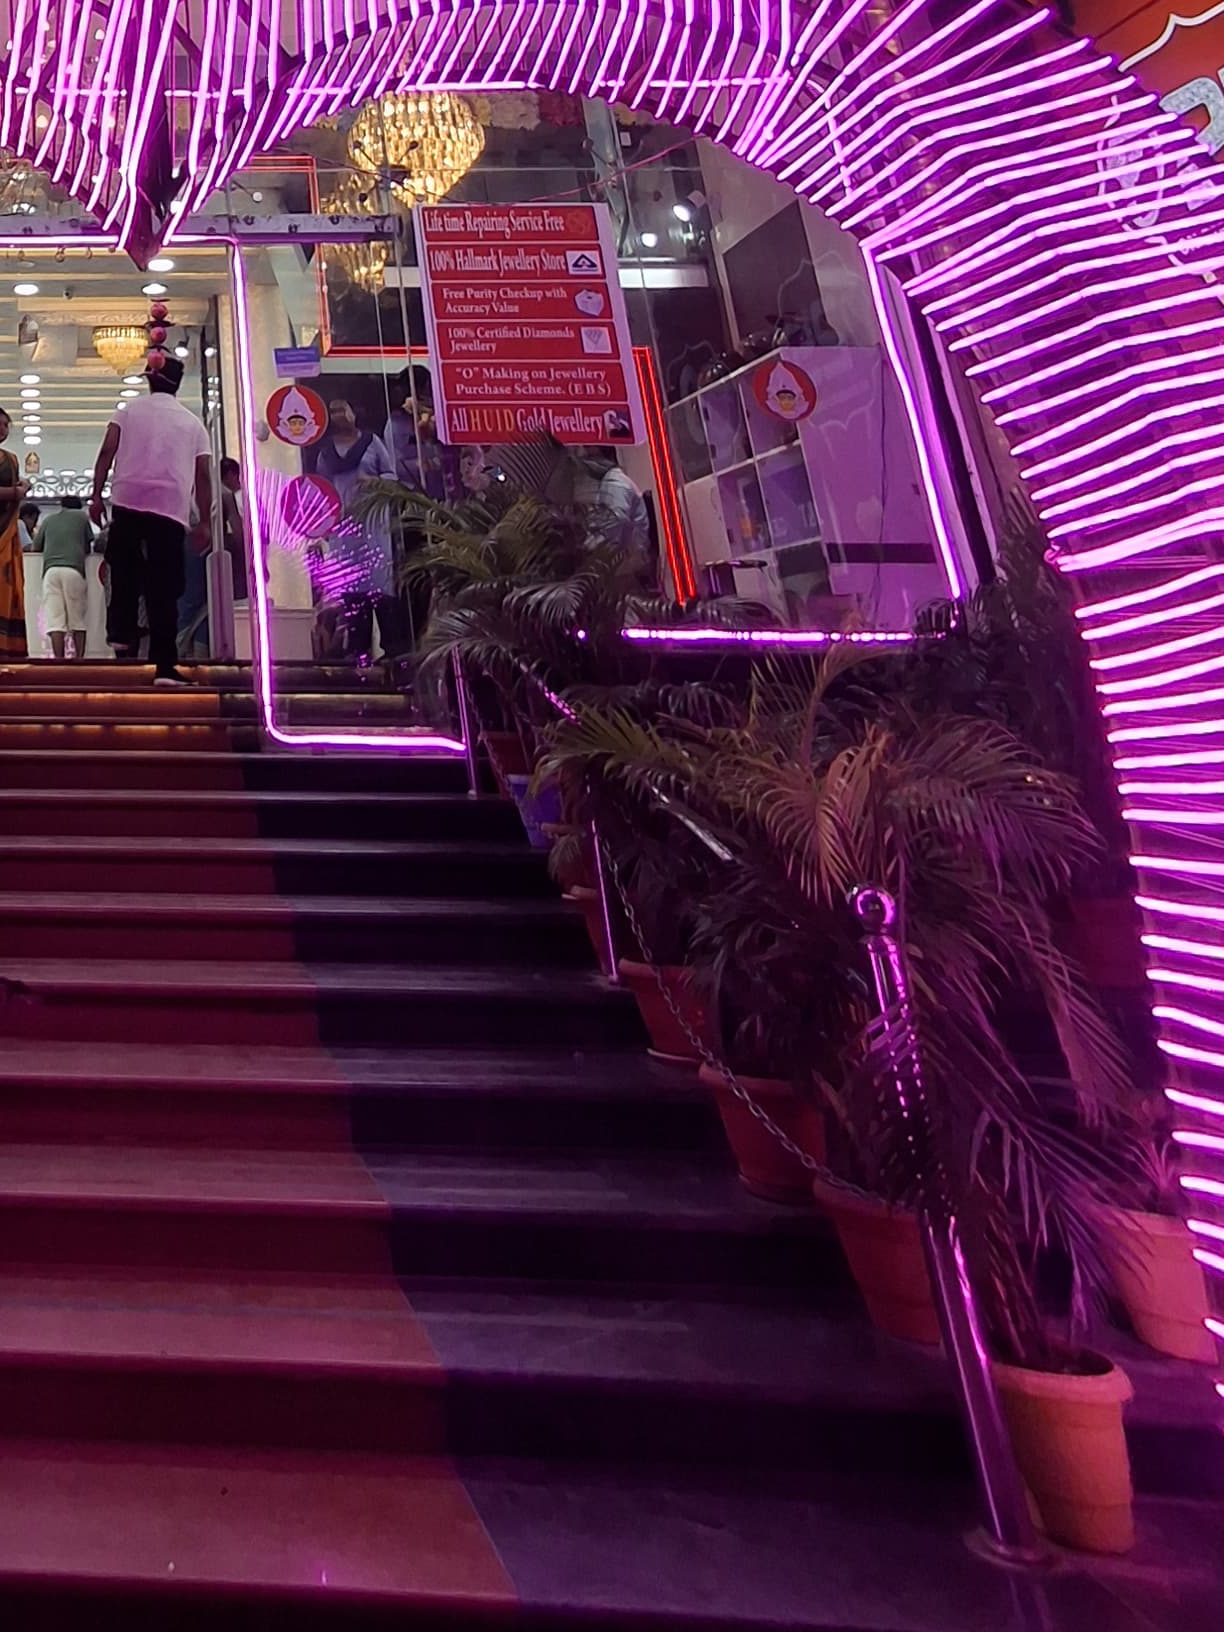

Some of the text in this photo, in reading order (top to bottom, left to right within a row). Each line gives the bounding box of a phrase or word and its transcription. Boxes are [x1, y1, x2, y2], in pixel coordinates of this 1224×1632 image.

[464, 210, 511, 239] Repairing
[510, 210, 544, 232] Service
[543, 210, 565, 231] Free
[455, 248, 499, 271] Hallmark
[498, 248, 541, 277] Jewellery
[541, 248, 566, 271] Store
[443, 287, 568, 302] Free Purity Checkup with
[445, 302, 520, 315] Accuracy Value
[448, 325, 575, 339] 100% Certified Diamonds
[450, 339, 497, 355] Jewellery
[482, 367, 529, 382] Making
[531, 369, 547, 380] on
[548, 367, 606, 382] Jewellery
[455, 383, 512, 395] Purchase
[451, 407, 469, 433] All
[516, 407, 546, 433] Gold
[547, 407, 604, 441] Jewellery
